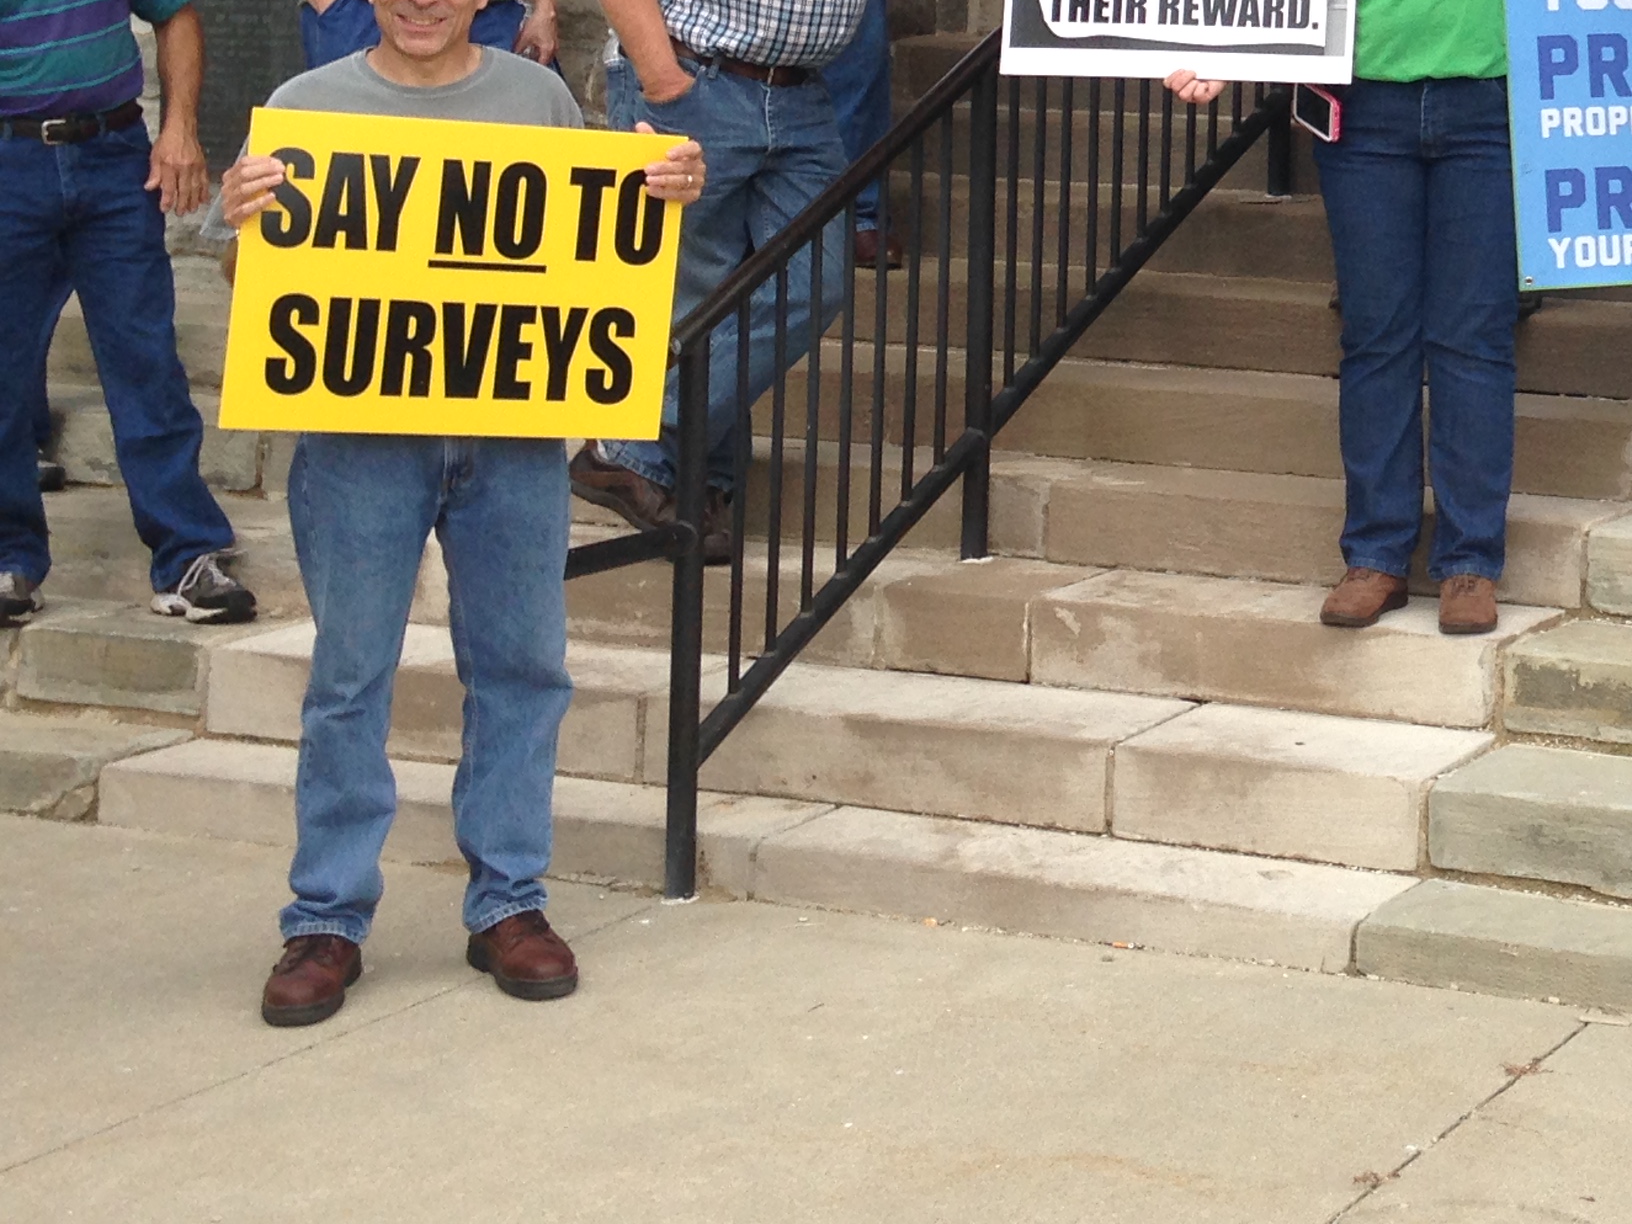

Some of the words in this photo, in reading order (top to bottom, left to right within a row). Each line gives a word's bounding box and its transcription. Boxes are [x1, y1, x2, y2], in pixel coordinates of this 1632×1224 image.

[261, 147, 420, 252] SAY
[433, 159, 547, 262] NO
[569, 166, 665, 266] TO
[265, 293, 636, 405] SURVEYS
